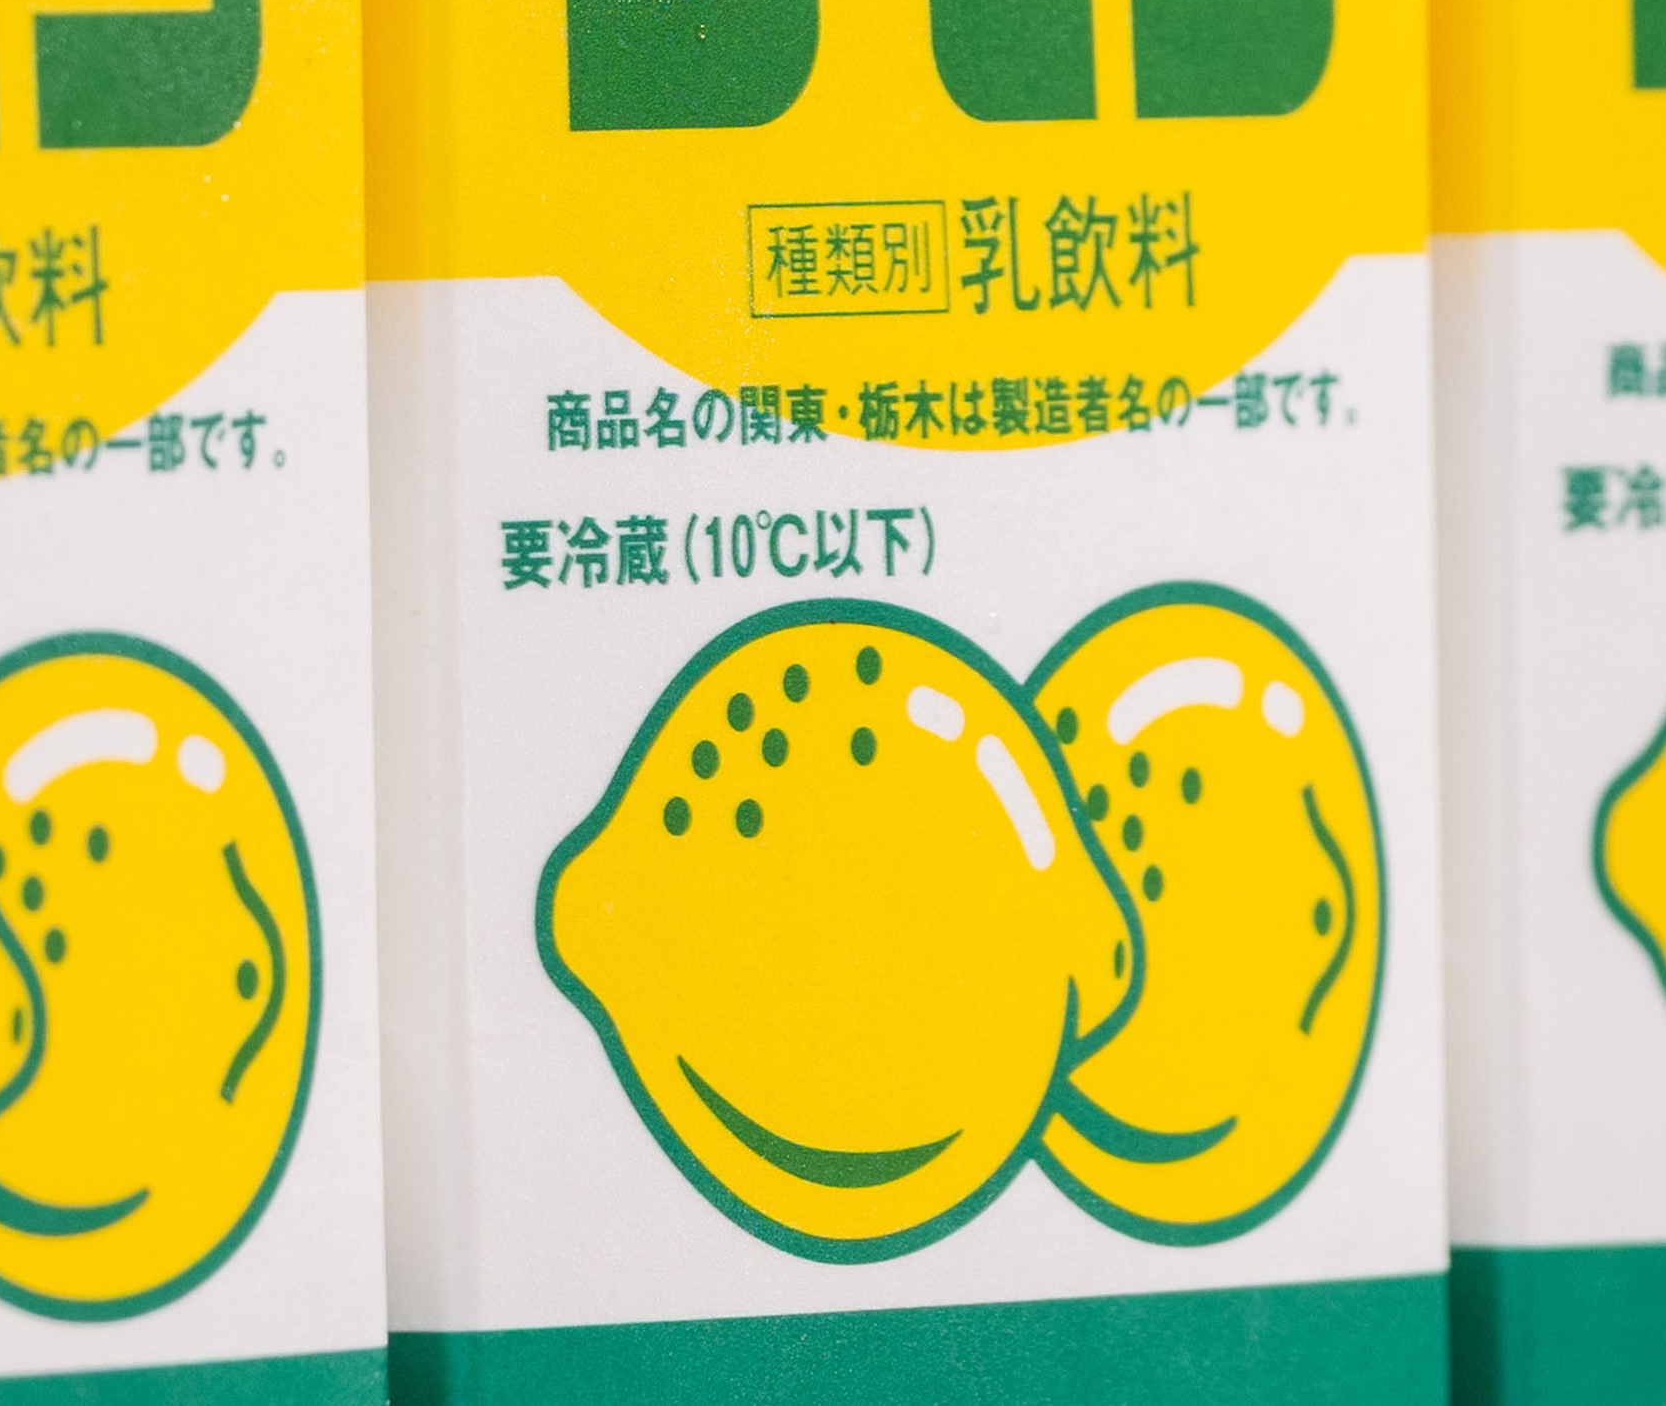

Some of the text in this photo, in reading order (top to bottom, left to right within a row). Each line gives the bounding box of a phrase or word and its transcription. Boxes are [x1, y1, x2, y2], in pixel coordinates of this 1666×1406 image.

[766, 191, 1199, 315] 種類別 乳飲料
